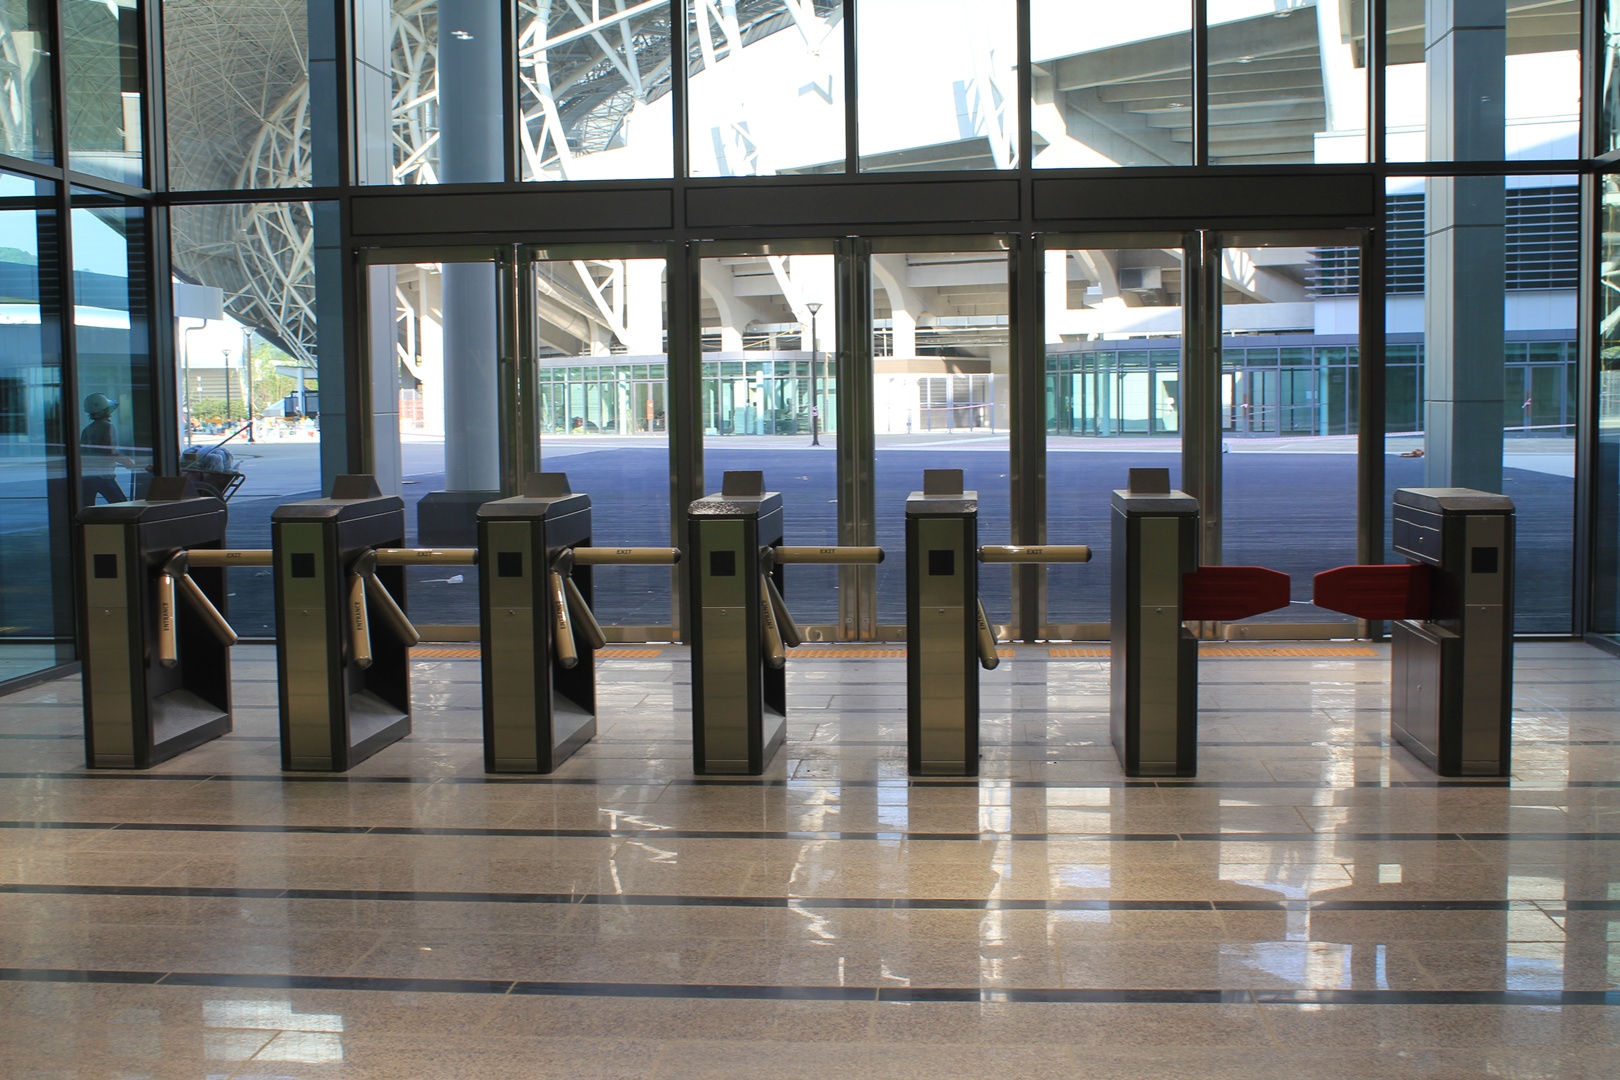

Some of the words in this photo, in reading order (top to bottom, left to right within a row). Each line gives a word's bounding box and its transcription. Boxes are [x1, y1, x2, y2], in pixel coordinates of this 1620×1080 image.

[162, 602, 170, 631] ENTRANCE
[354, 602, 363, 631] ENTRANCE
[555, 601, 566, 630] ENTRANCE
[762, 600, 774, 630] ENTRANCE
